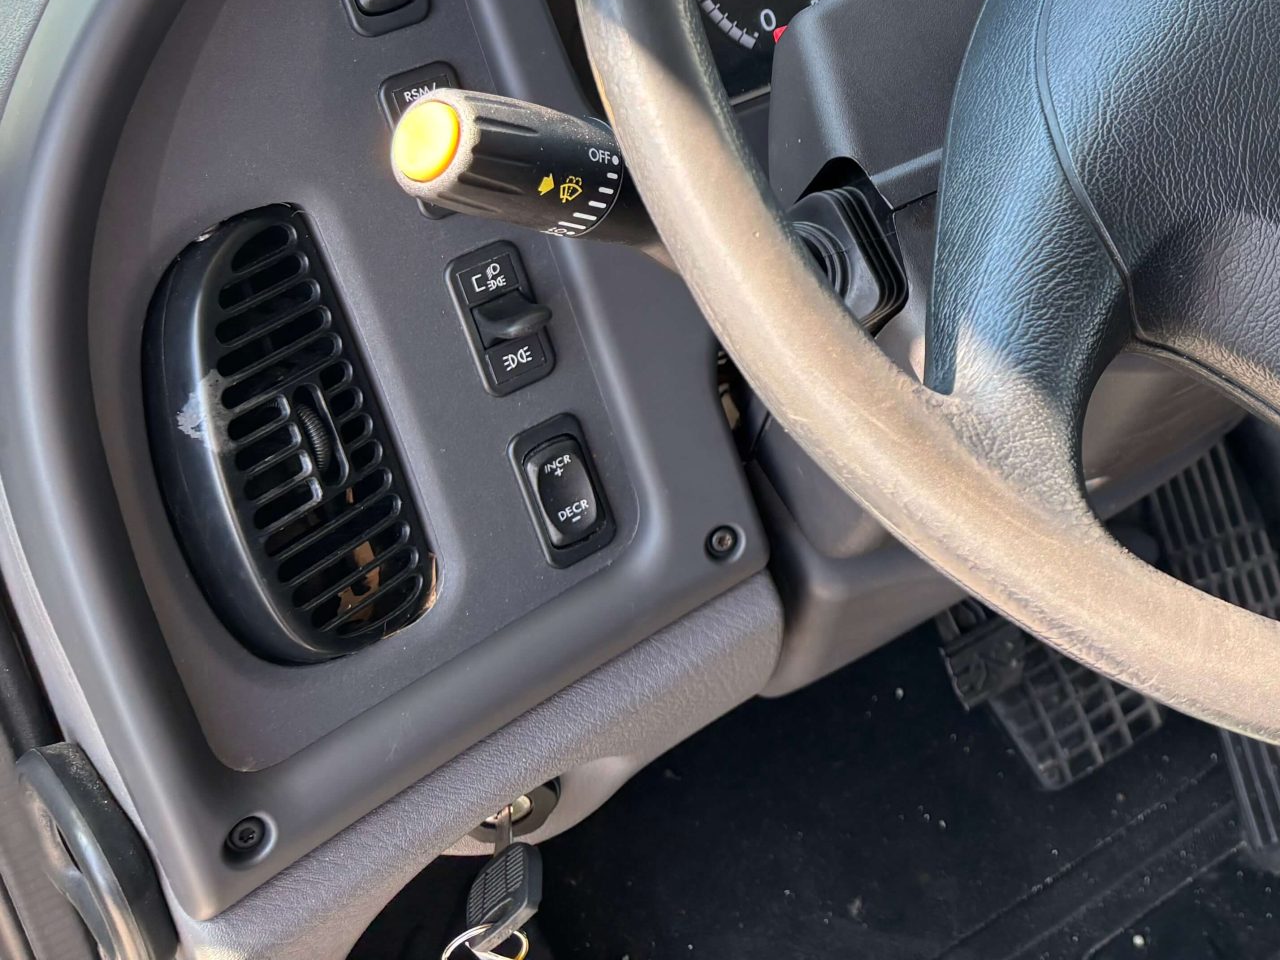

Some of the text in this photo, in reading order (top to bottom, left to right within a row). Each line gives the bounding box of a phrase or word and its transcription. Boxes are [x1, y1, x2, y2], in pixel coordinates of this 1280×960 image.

[759, 8, 777, 32] 0
[588, 147, 611, 165] OFF
[544, 454, 572, 474] INCR
[557, 499, 589, 522] DECR
